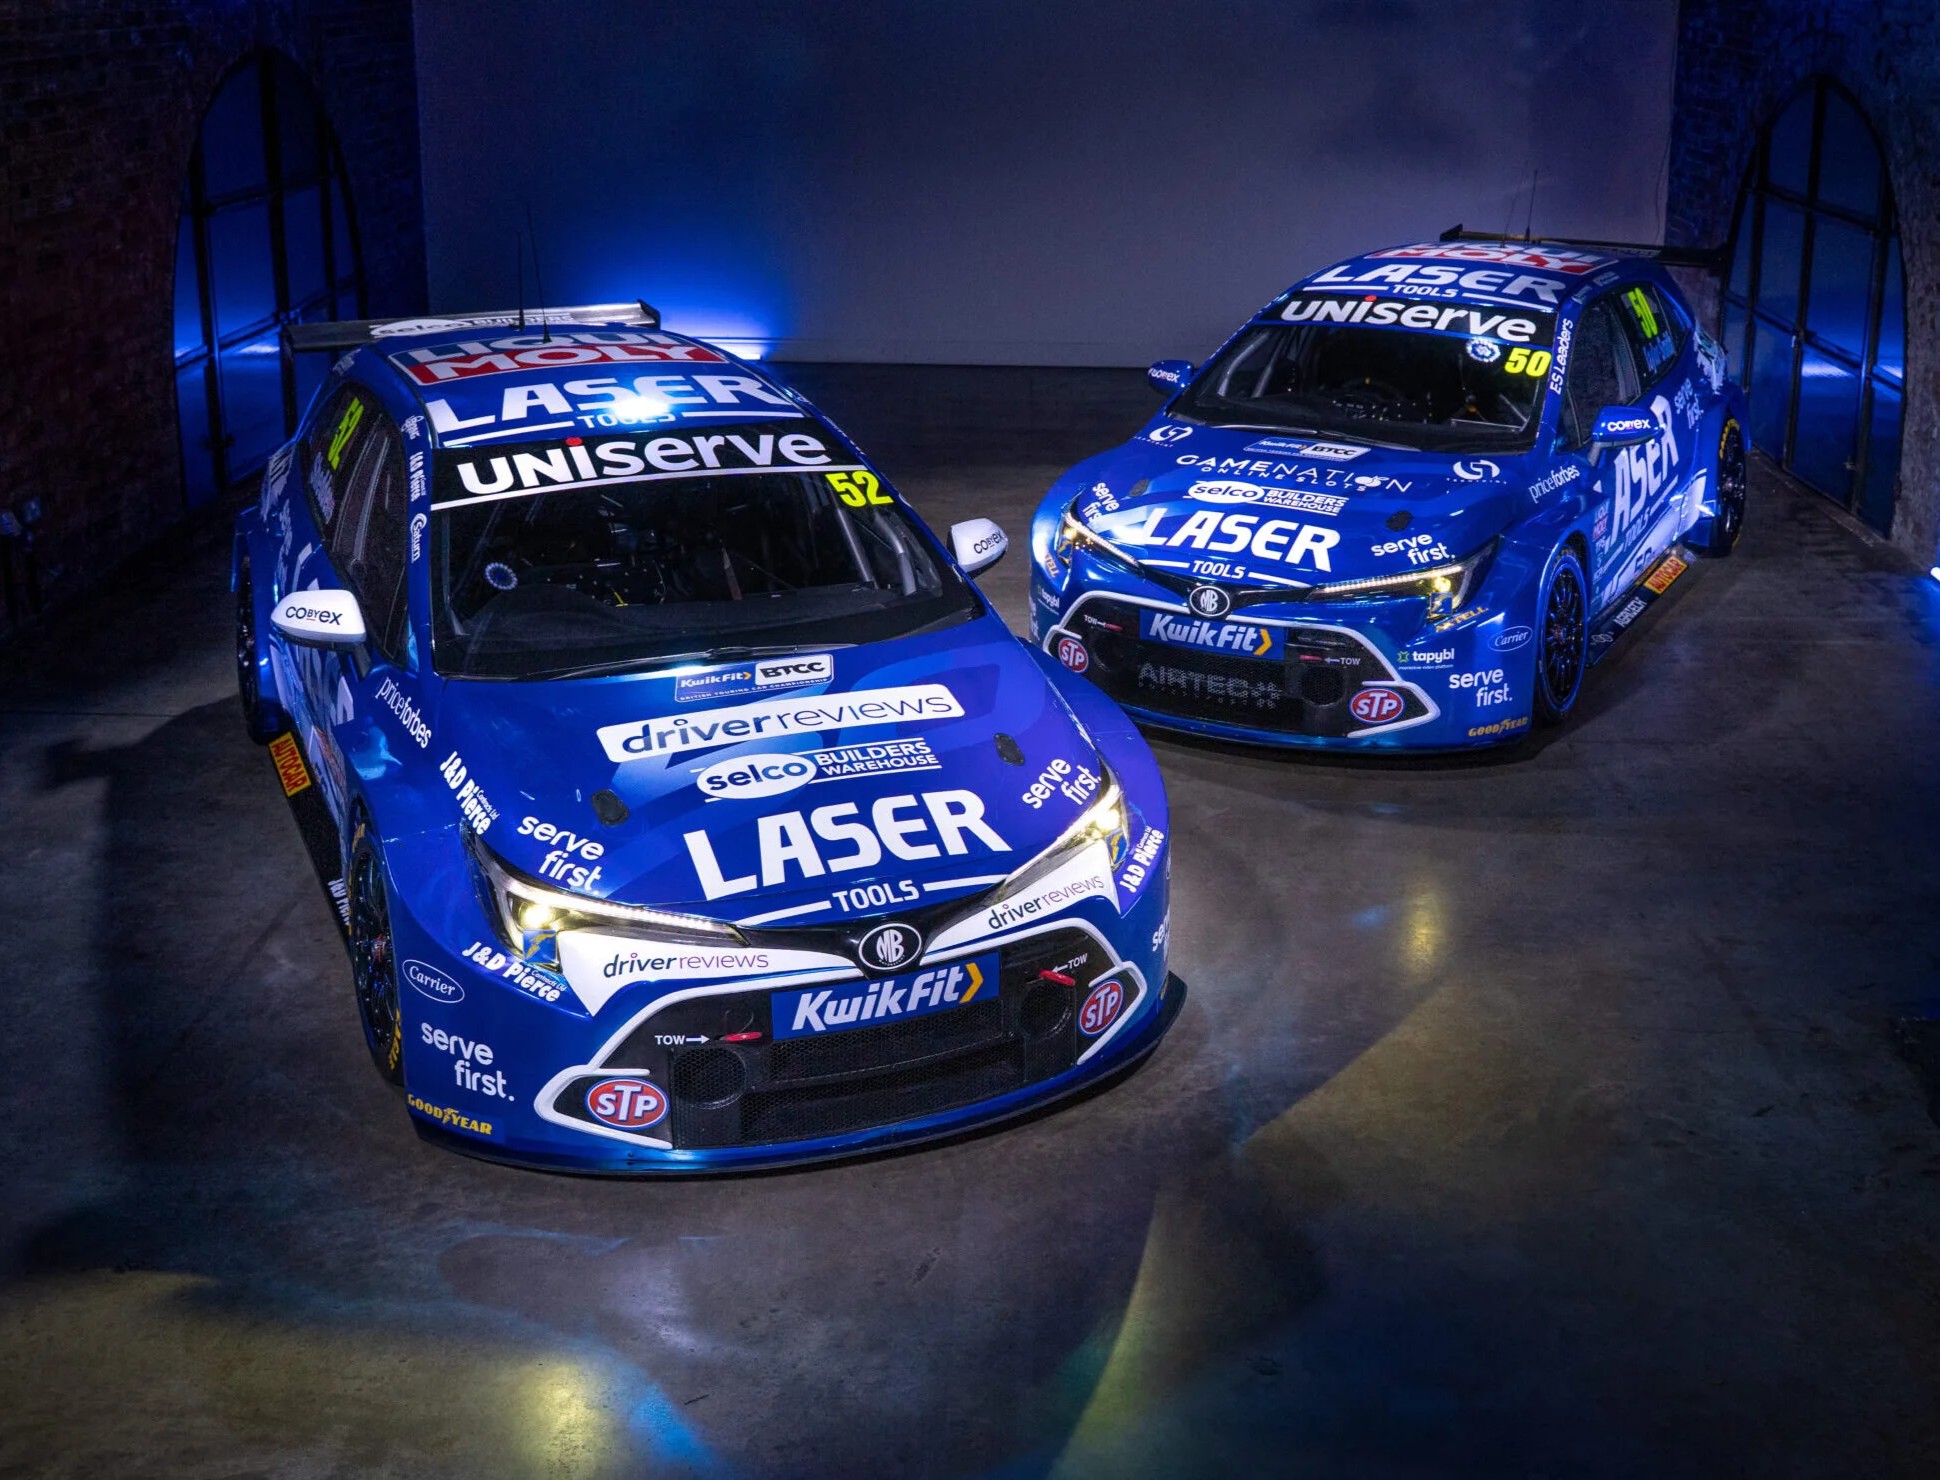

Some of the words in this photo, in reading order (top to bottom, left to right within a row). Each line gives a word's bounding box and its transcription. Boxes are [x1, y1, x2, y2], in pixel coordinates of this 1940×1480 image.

[1389, 249, 1594, 271] MOLY
[1312, 264, 1567, 304] LASER
[1393, 284, 1458, 298] TOOLS
[406, 332, 682, 367] LIQUI
[1556, 318, 1574, 374] Leaders
[425, 343, 699, 380] MOLY
[1504, 348, 1552, 378] 50
[1550, 372, 1563, 395] ES
[426, 375, 797, 433] LASER
[1311, 445, 1357, 456] BTCC
[825, 470, 894, 508] 52
[1193, 483, 1258, 499] selco
[1201, 466, 1286, 481] ONLINE
[1296, 476, 1368, 492] SLOTS
[1092, 482, 1120, 512] serve
[1263, 497, 1342, 514] WAREHOUSE
[1265, 489, 1347, 507] BUILDERS
[1144, 507, 1341, 573] LASER
[1371, 534, 1433, 557] serve
[1193, 560, 1246, 579] TOOLS
[1200, 590, 1218, 613] MB
[1494, 630, 1529, 647] Carrier
[1061, 641, 1086, 667] STP
[1340, 657, 1361, 666] TOW
[1412, 648, 1455, 663] tapybl
[760, 661, 825, 679] BTCC
[1449, 669, 1504, 689] serve
[1356, 692, 1397, 718] STP
[271, 738, 309, 793] AUTOCAR
[815, 741, 932, 766] BUILDERS
[822, 753, 939, 777] WAREHOUSE
[706, 762, 809, 792] selco
[1022, 757, 1072, 809] serve
[440, 751, 467, 789] J&D
[456, 779, 492, 835] Pierce
[517, 816, 605, 860] serve
[683, 789, 1013, 902] LASER
[1119, 864, 1146, 893] J&D
[1133, 828, 1165, 867] Pierce
[832, 879, 919, 913] TOOLS
[876, 928, 905, 964] MB
[1067, 952, 1088, 969] TOW
[408, 965, 456, 996] Carrier
[462, 941, 507, 971] J&D
[502, 960, 561, 1002] Pierce
[1084, 982, 1123, 1029] STP
[421, 1022, 494, 1065] serve
[655, 1034, 685, 1045] TOW
[454, 1060, 515, 1102] first.
[596, 1084, 658, 1121] STP
